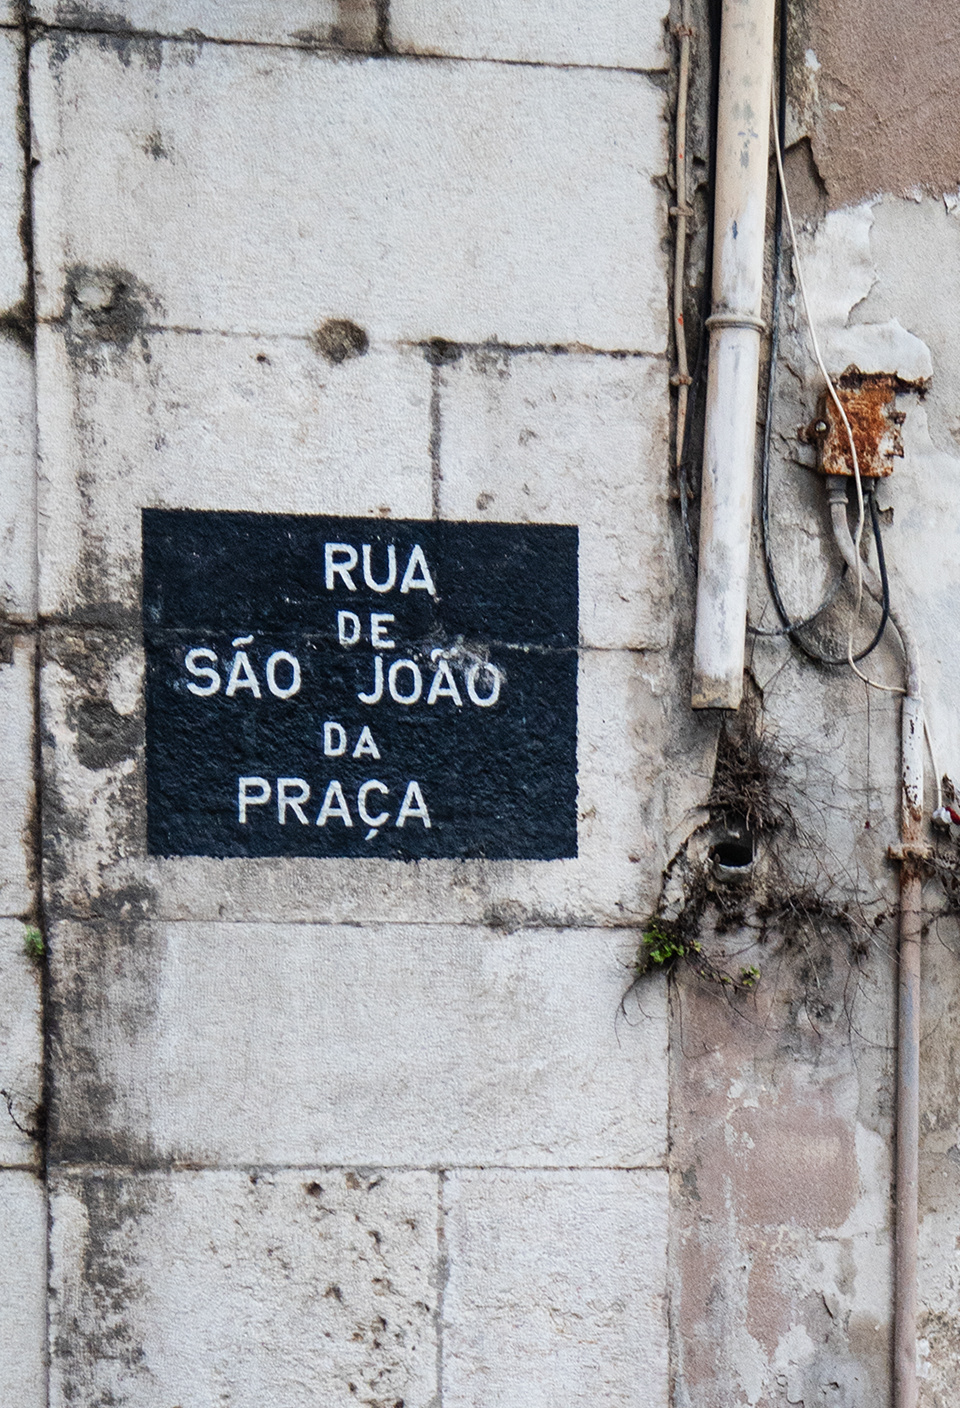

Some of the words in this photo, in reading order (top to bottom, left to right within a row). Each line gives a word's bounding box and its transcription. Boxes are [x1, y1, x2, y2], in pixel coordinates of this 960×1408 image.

[324, 542, 436, 596] RUA
[337, 610, 396, 649] DE
[184, 634, 302, 700] SÃO
[357, 647, 502, 708] JOÃO
[323, 721, 381, 760] DA
[238, 776, 432, 841] PRAÇA
